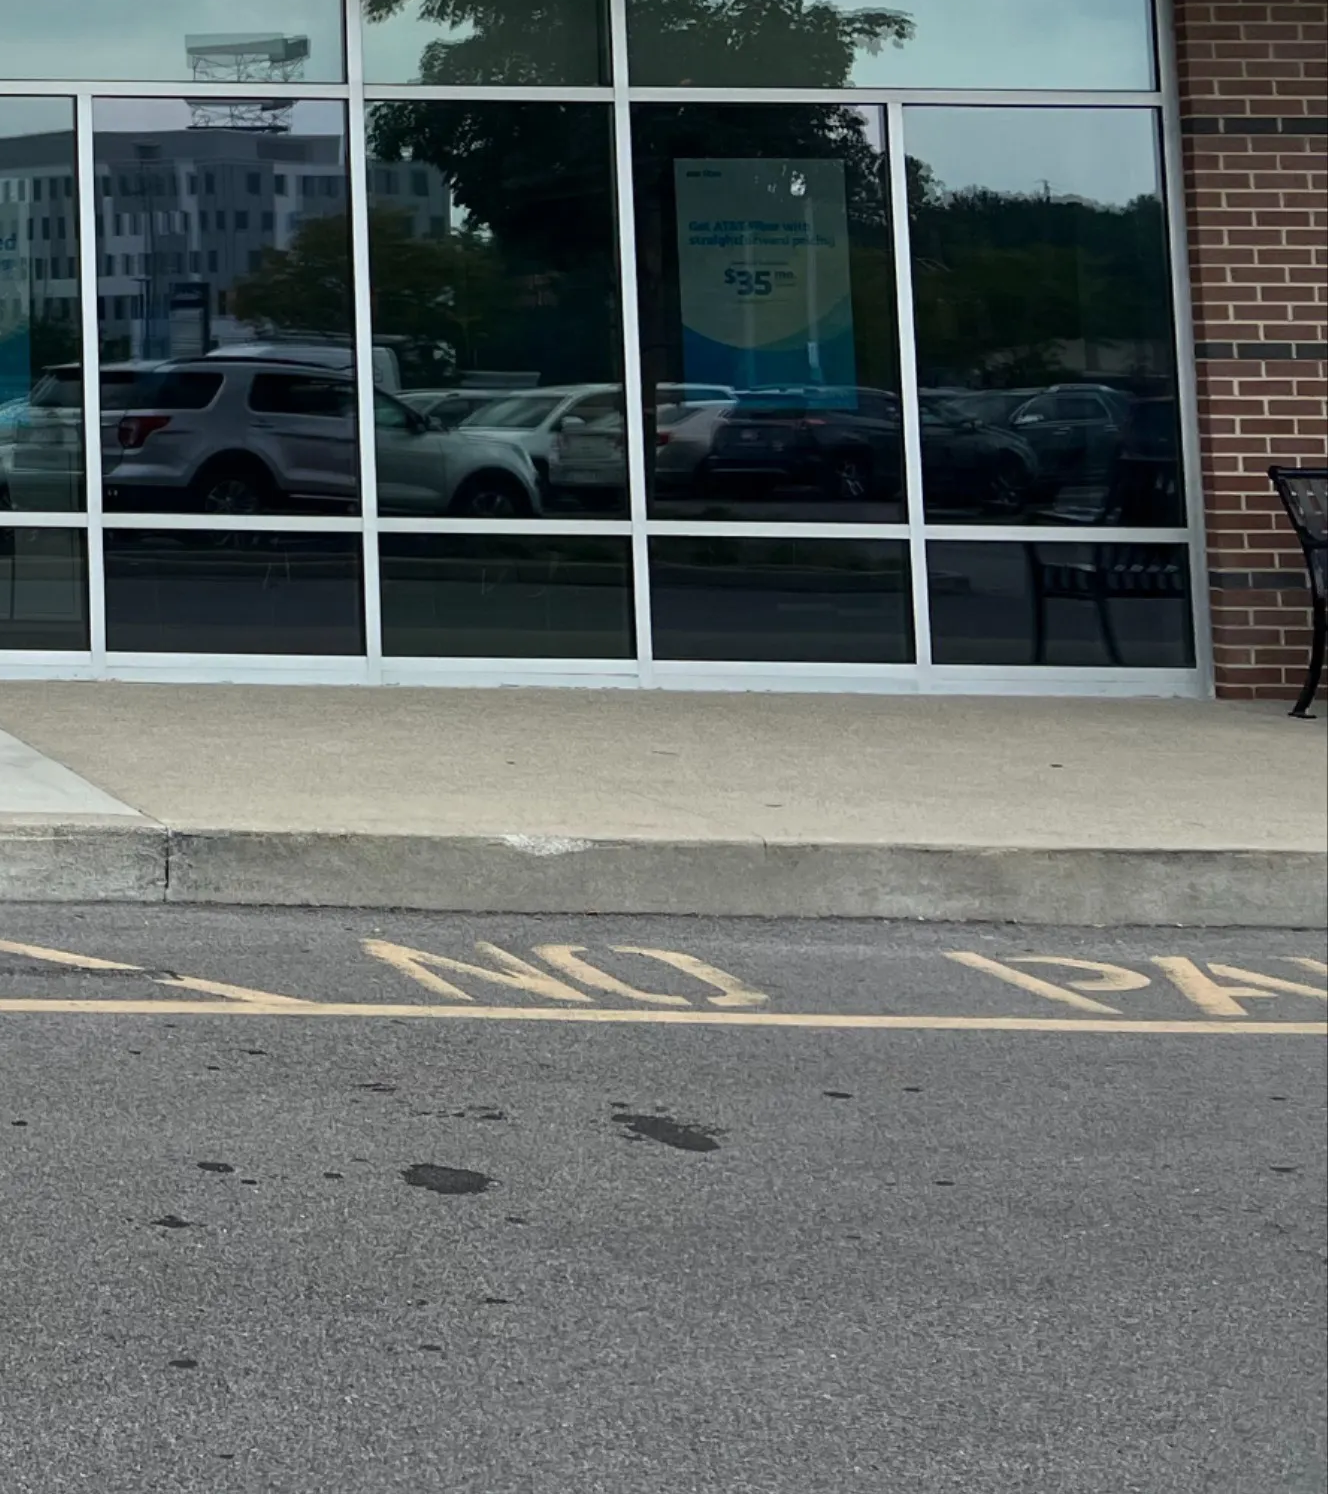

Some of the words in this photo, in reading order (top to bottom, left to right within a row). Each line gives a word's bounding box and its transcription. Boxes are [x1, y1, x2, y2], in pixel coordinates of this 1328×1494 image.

[689, 221, 711, 232] Get
[713, 220, 746, 232] AT&T
[782, 221, 810, 232] with
[724, 268, 773, 296] $35
[358, 938, 771, 1006] NO
[940, 950, 1328, 1016] PA
